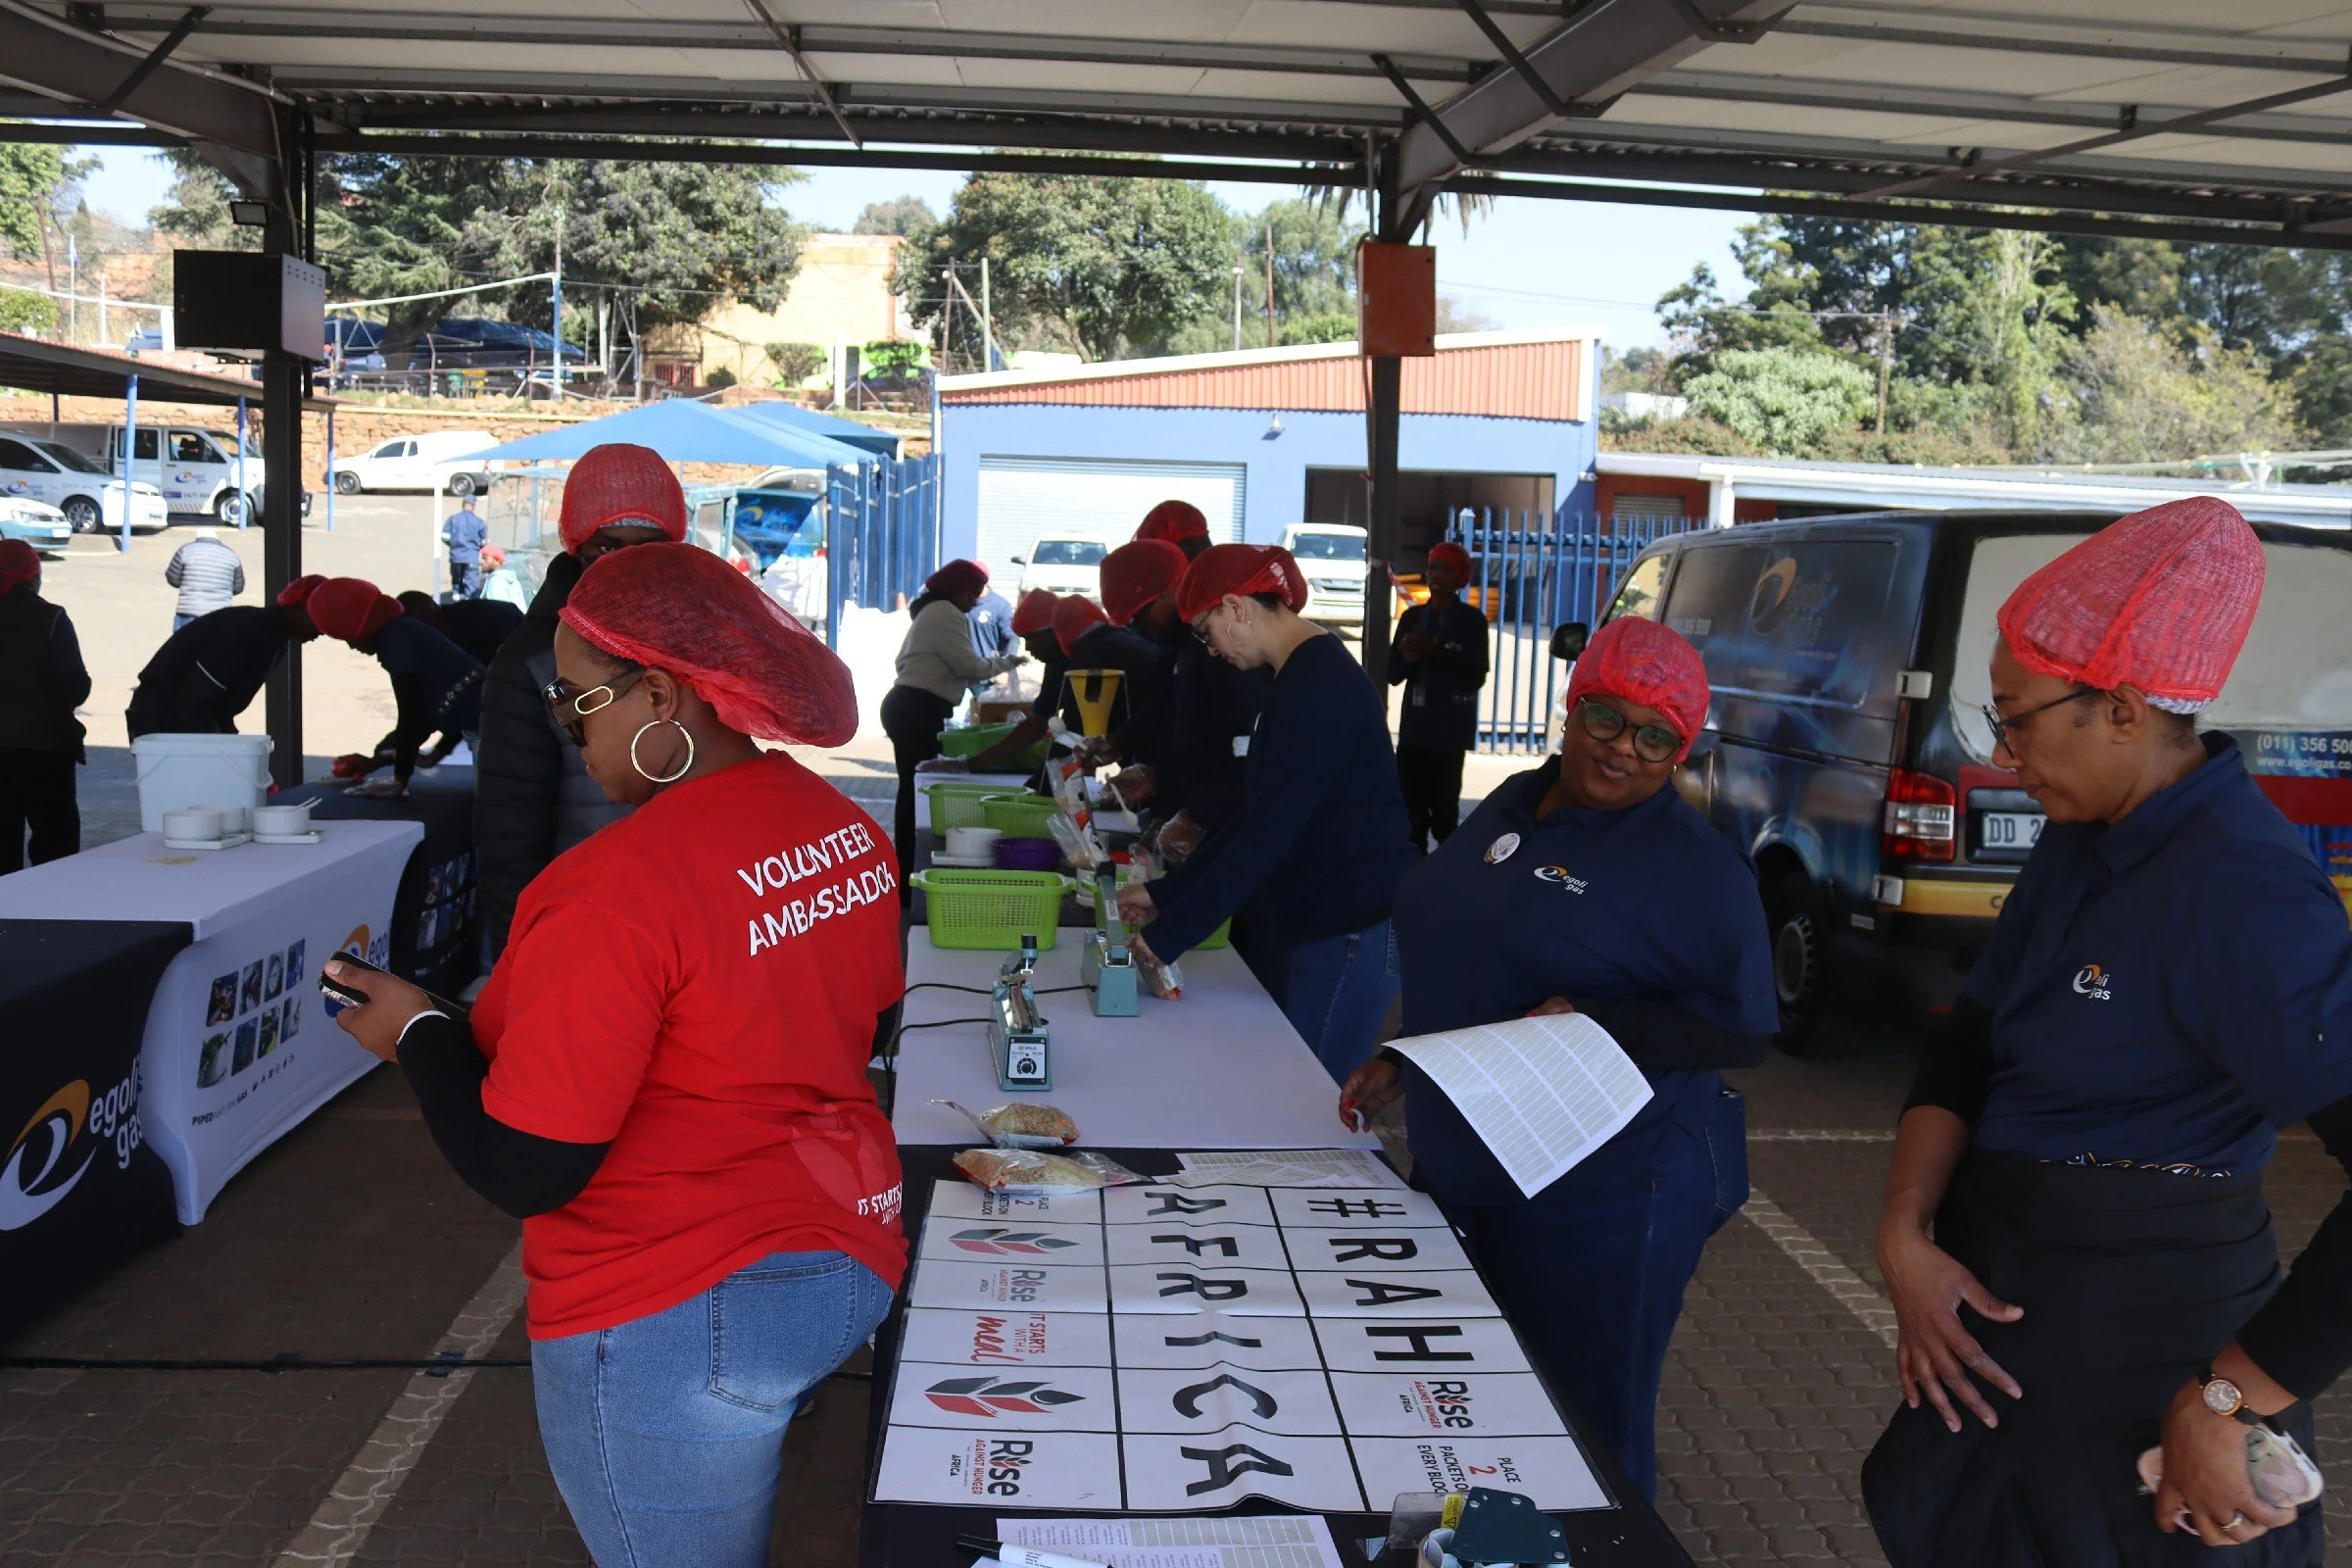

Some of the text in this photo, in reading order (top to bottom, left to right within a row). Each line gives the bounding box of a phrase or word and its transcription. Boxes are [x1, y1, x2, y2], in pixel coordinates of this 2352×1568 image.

[2257, 734, 2296, 753] (011)
[2300, 736, 2328, 753] 356
[1988, 817, 2016, 843] DD
[737, 822, 875, 897] VOLUNTEER
[1565, 883, 1584, 895] gas
[857, 1198, 869, 1215] IT
[1010, 1269, 1047, 1302] Rise
[970, 1315, 1024, 1362] meal
[1014, 1328, 1026, 1348] WITH
[1028, 1313, 1046, 1354] IT STARTS
[1399, 1394, 1413, 1413] AFRICA
[1414, 1381, 1432, 1404] AGAINST
[1425, 1404, 1443, 1429] HUNGER
[1427, 1381, 1474, 1429] Rise
[950, 1454, 961, 1476] AFRICA
[971, 1439, 986, 1495] AGAINST HUNGER
[987, 1439, 1034, 1496] Rise
[1417, 1445, 1439, 1470] EVERY
[1428, 1471, 1448, 1494] BLOC
[1439, 1446, 1466, 1482] PACKETS
[1468, 1465, 1497, 1475] 2
[1497, 1457, 1522, 1483] PLACE
